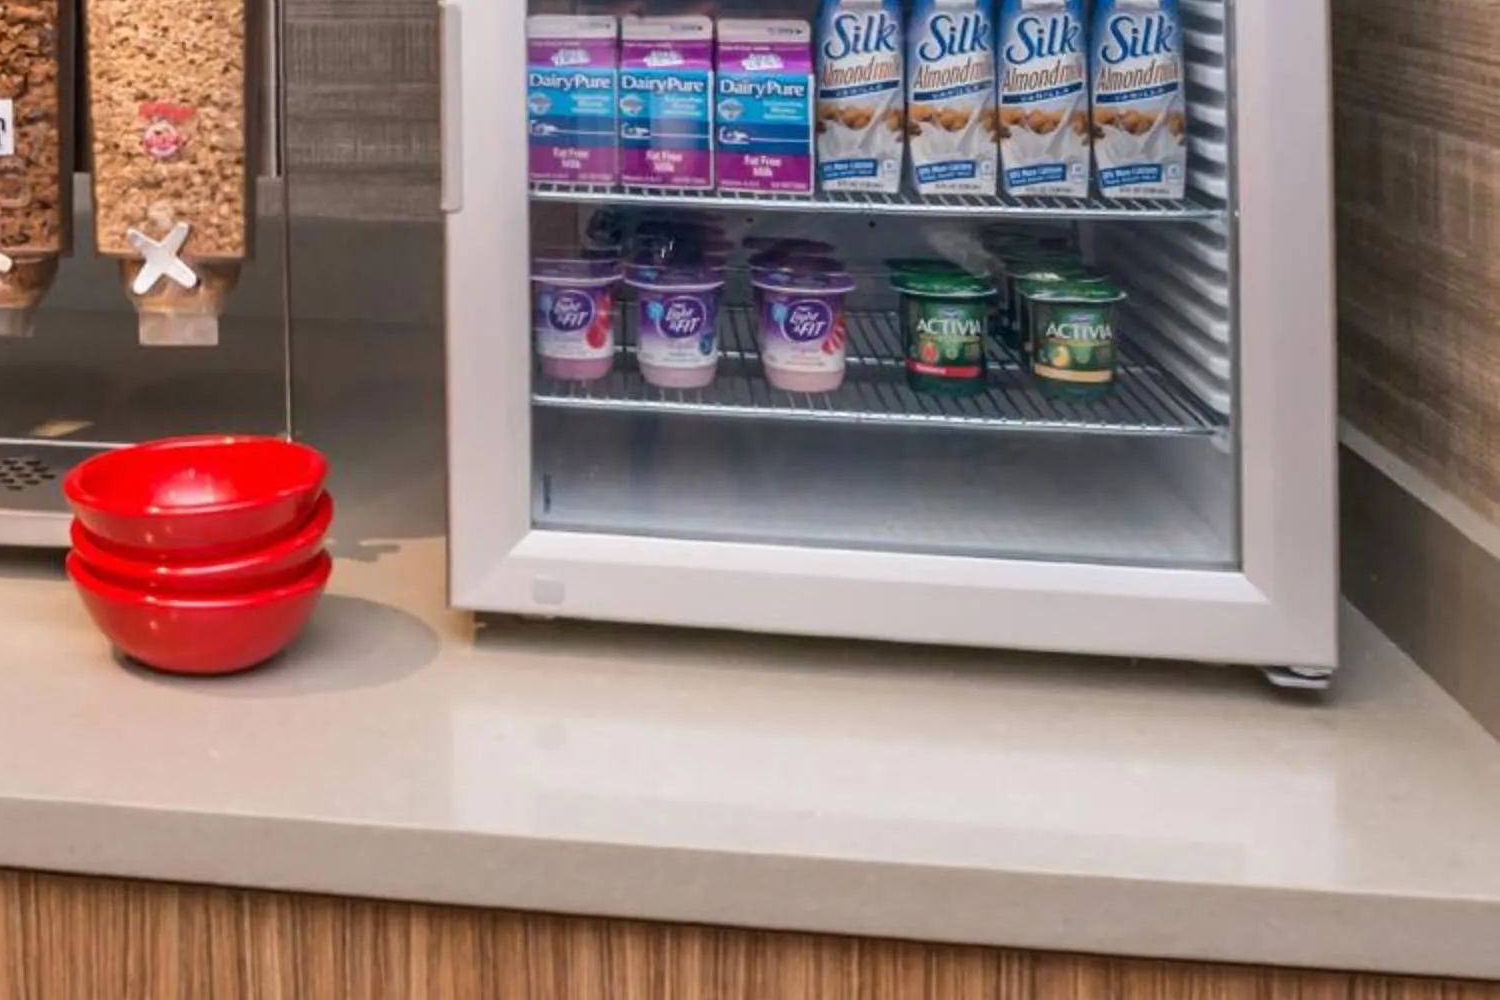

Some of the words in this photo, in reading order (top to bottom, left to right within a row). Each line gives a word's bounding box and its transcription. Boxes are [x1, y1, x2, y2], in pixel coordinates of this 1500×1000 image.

[824, 13, 897, 60] Silk
[919, 13, 989, 62] Silk
[1006, 15, 1080, 65] Silk
[1102, 15, 1174, 64] Silk
[528, 73, 611, 91] DairyPure
[622, 75, 704, 94] DairyPure
[720, 79, 804, 98] DairyPure
[1045, 322, 1112, 340] ACTIVIA
